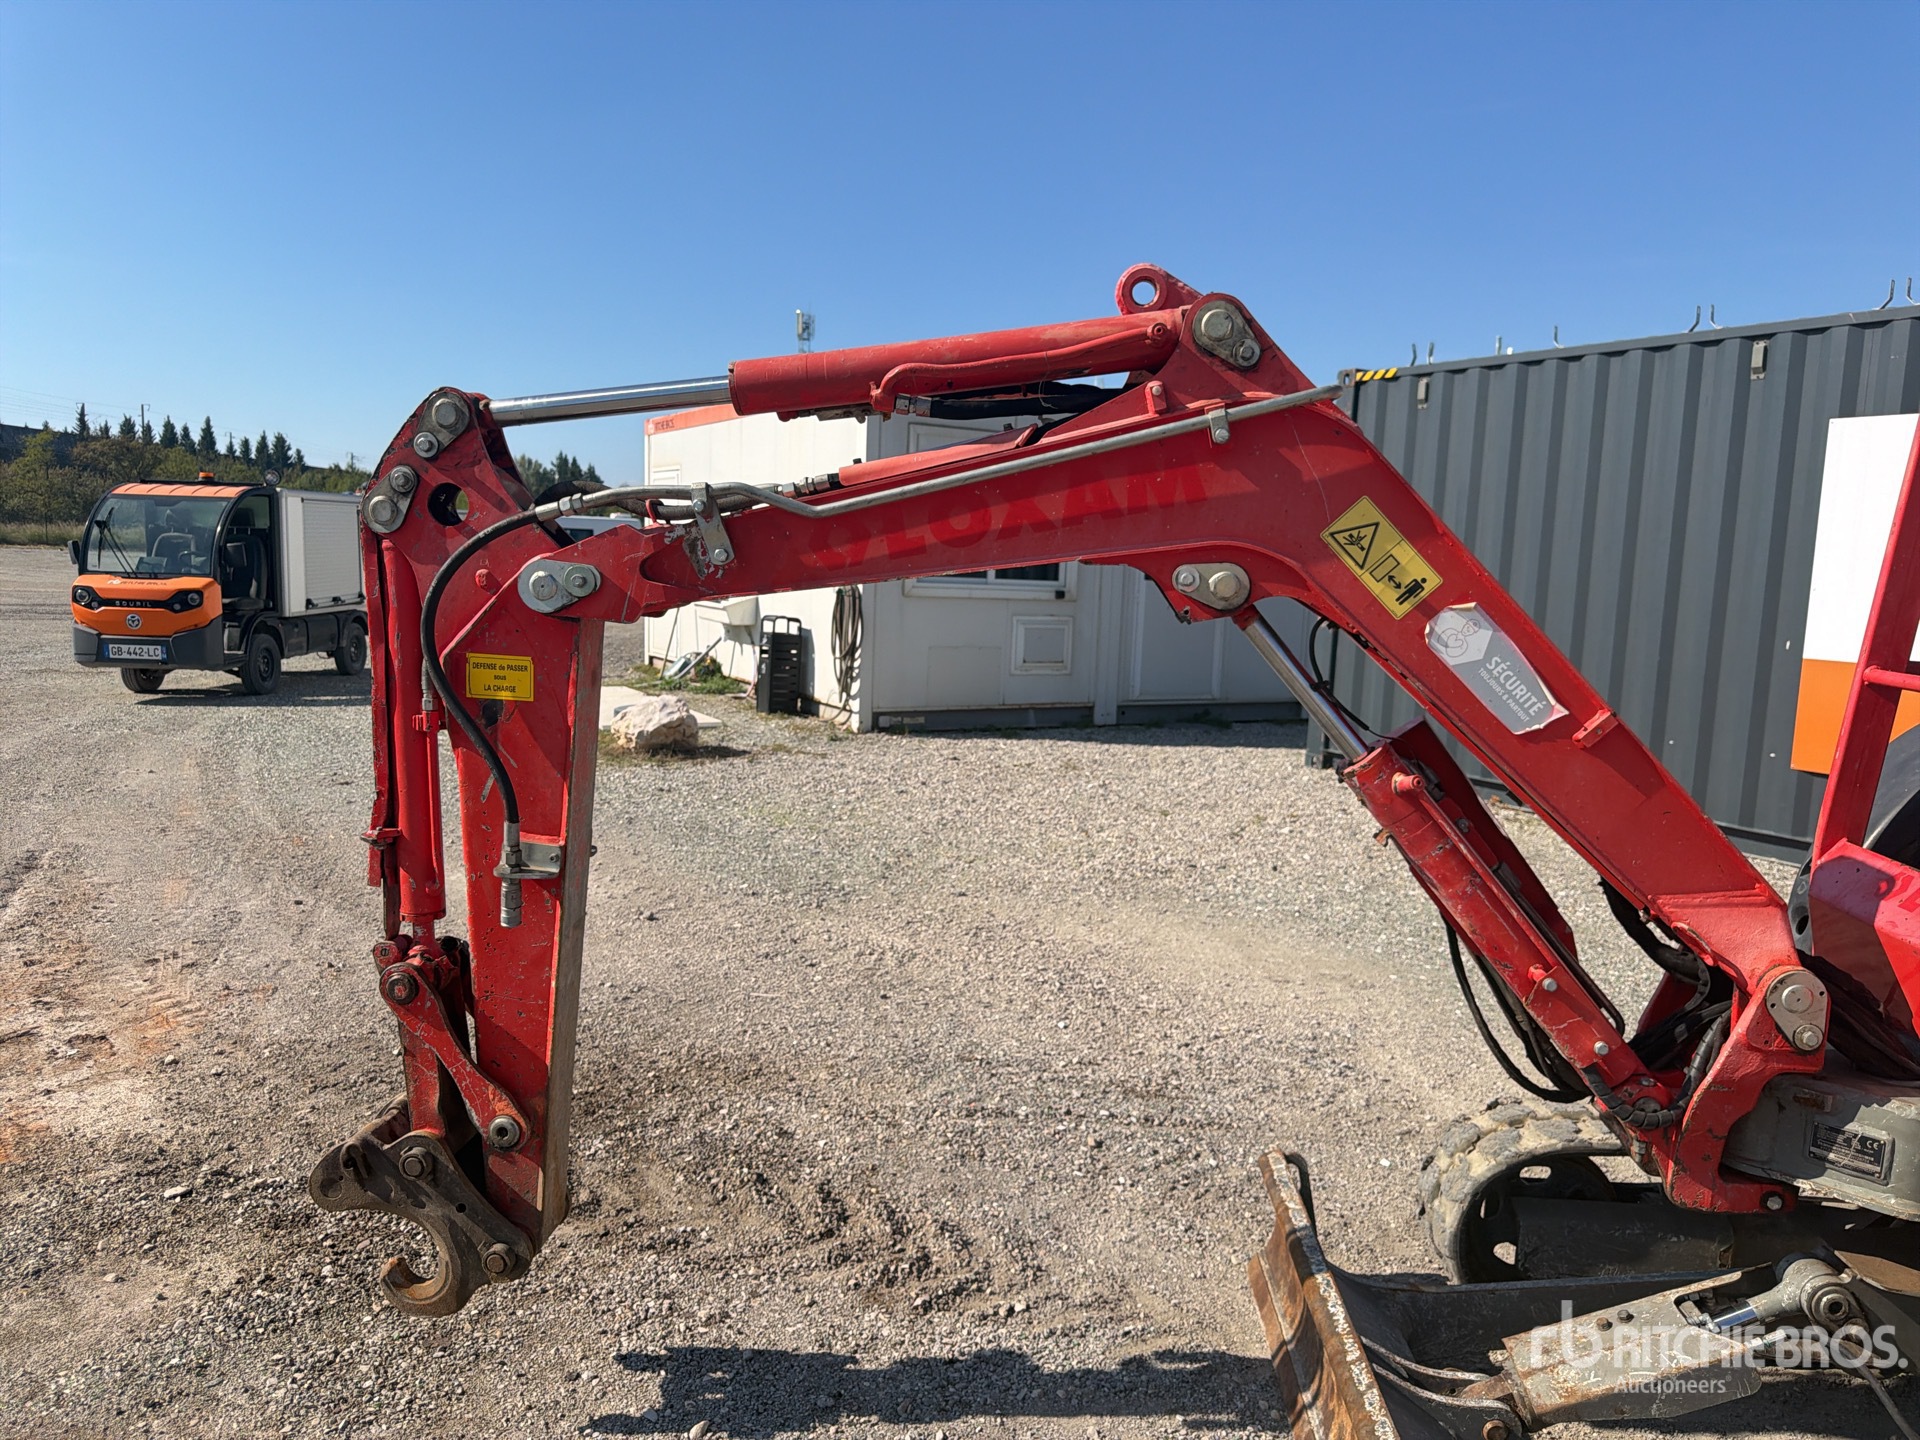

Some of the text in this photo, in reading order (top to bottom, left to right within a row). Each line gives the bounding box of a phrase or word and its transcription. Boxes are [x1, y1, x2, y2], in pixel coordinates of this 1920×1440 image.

[873, 450, 1208, 560] LOXAM
[111, 646, 160, 658] GB-442-LC
[472, 662, 497, 671] DEFENSE
[506, 664, 529, 672] PASSER
[492, 685, 517, 693] CHARGE
[1478, 667, 1504, 696] TOUJOURS
[1506, 698, 1530, 722] PARTOUT
[1485, 656, 1547, 716] SÉCURITÉ
